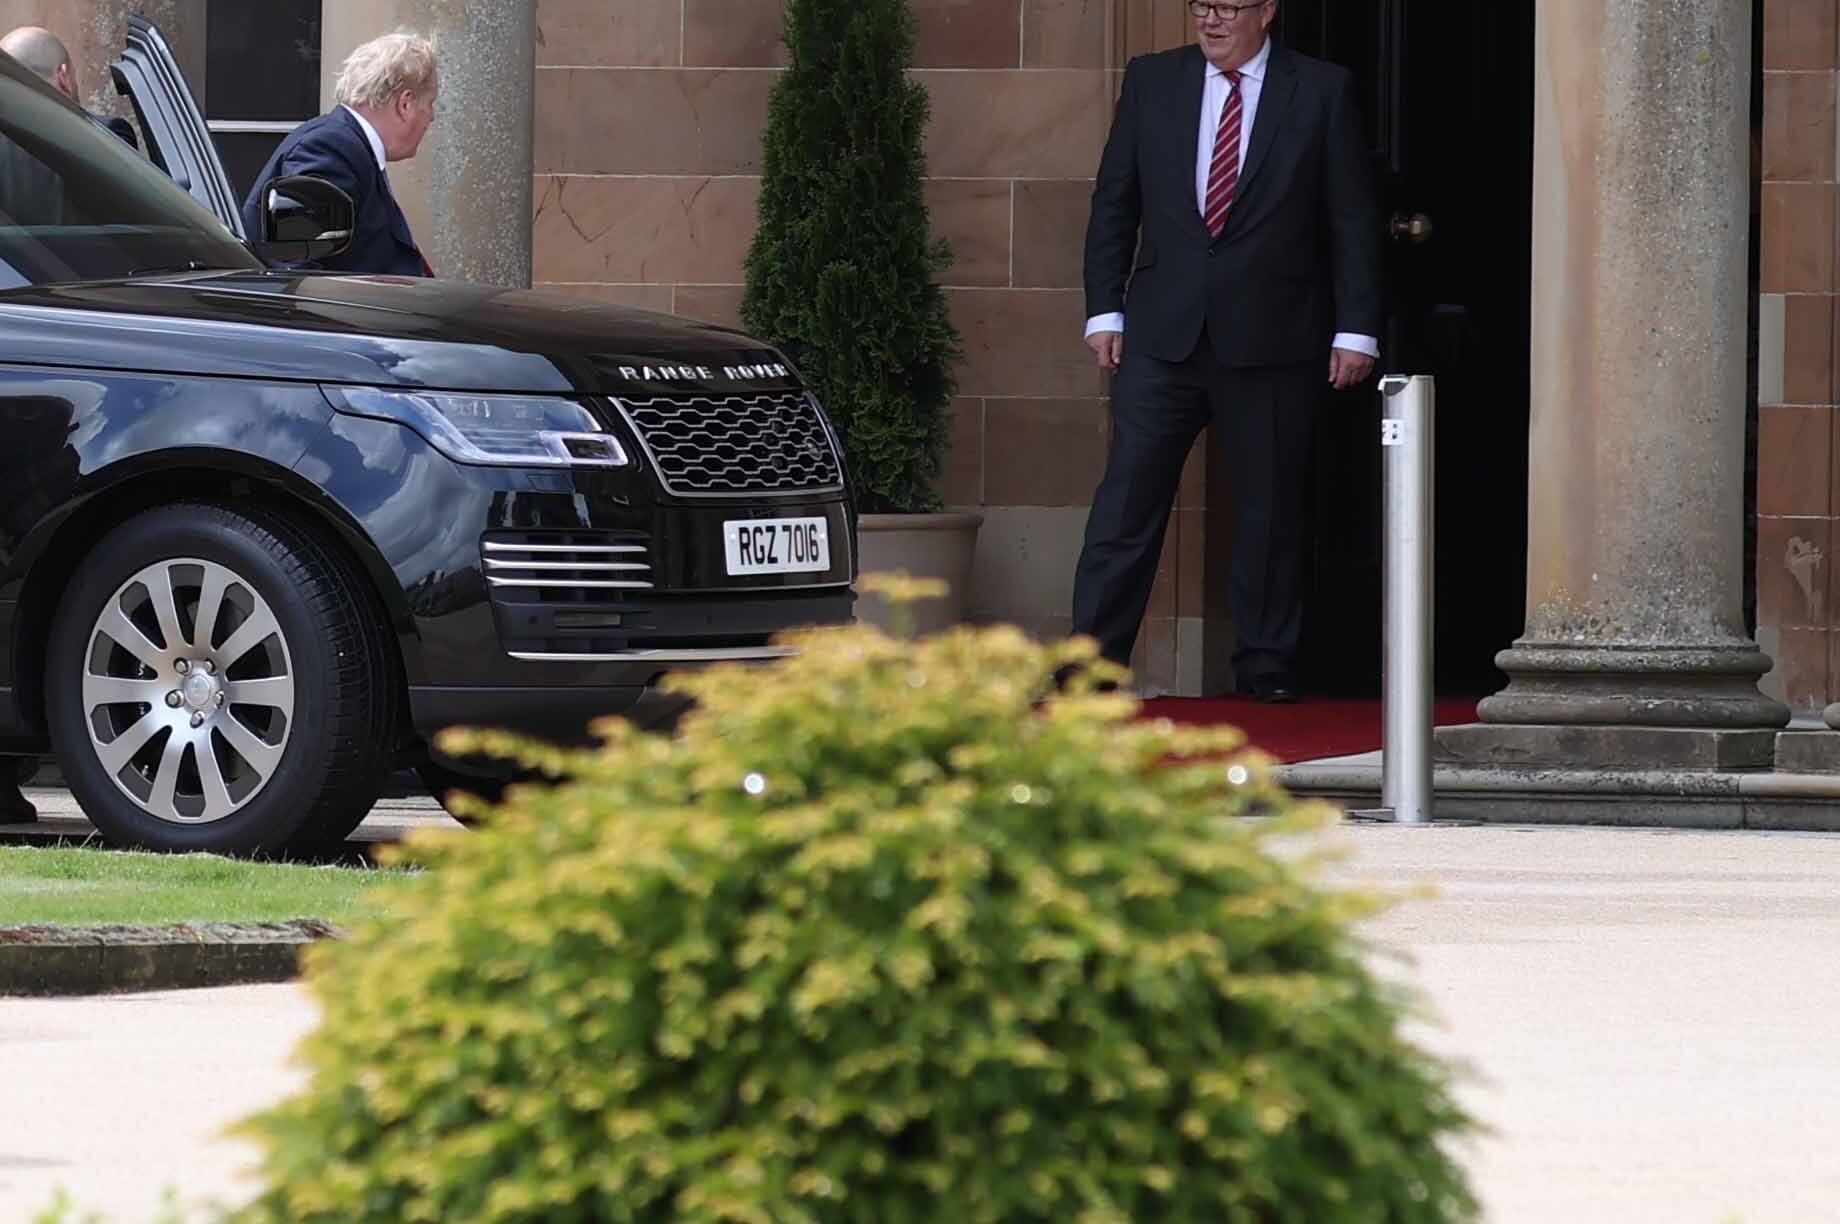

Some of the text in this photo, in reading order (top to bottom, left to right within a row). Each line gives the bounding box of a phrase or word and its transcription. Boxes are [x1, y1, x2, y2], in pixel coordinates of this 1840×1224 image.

[618, 363, 788, 380] RANGE ROVER
[738, 524, 819, 565] RGZ 7016
